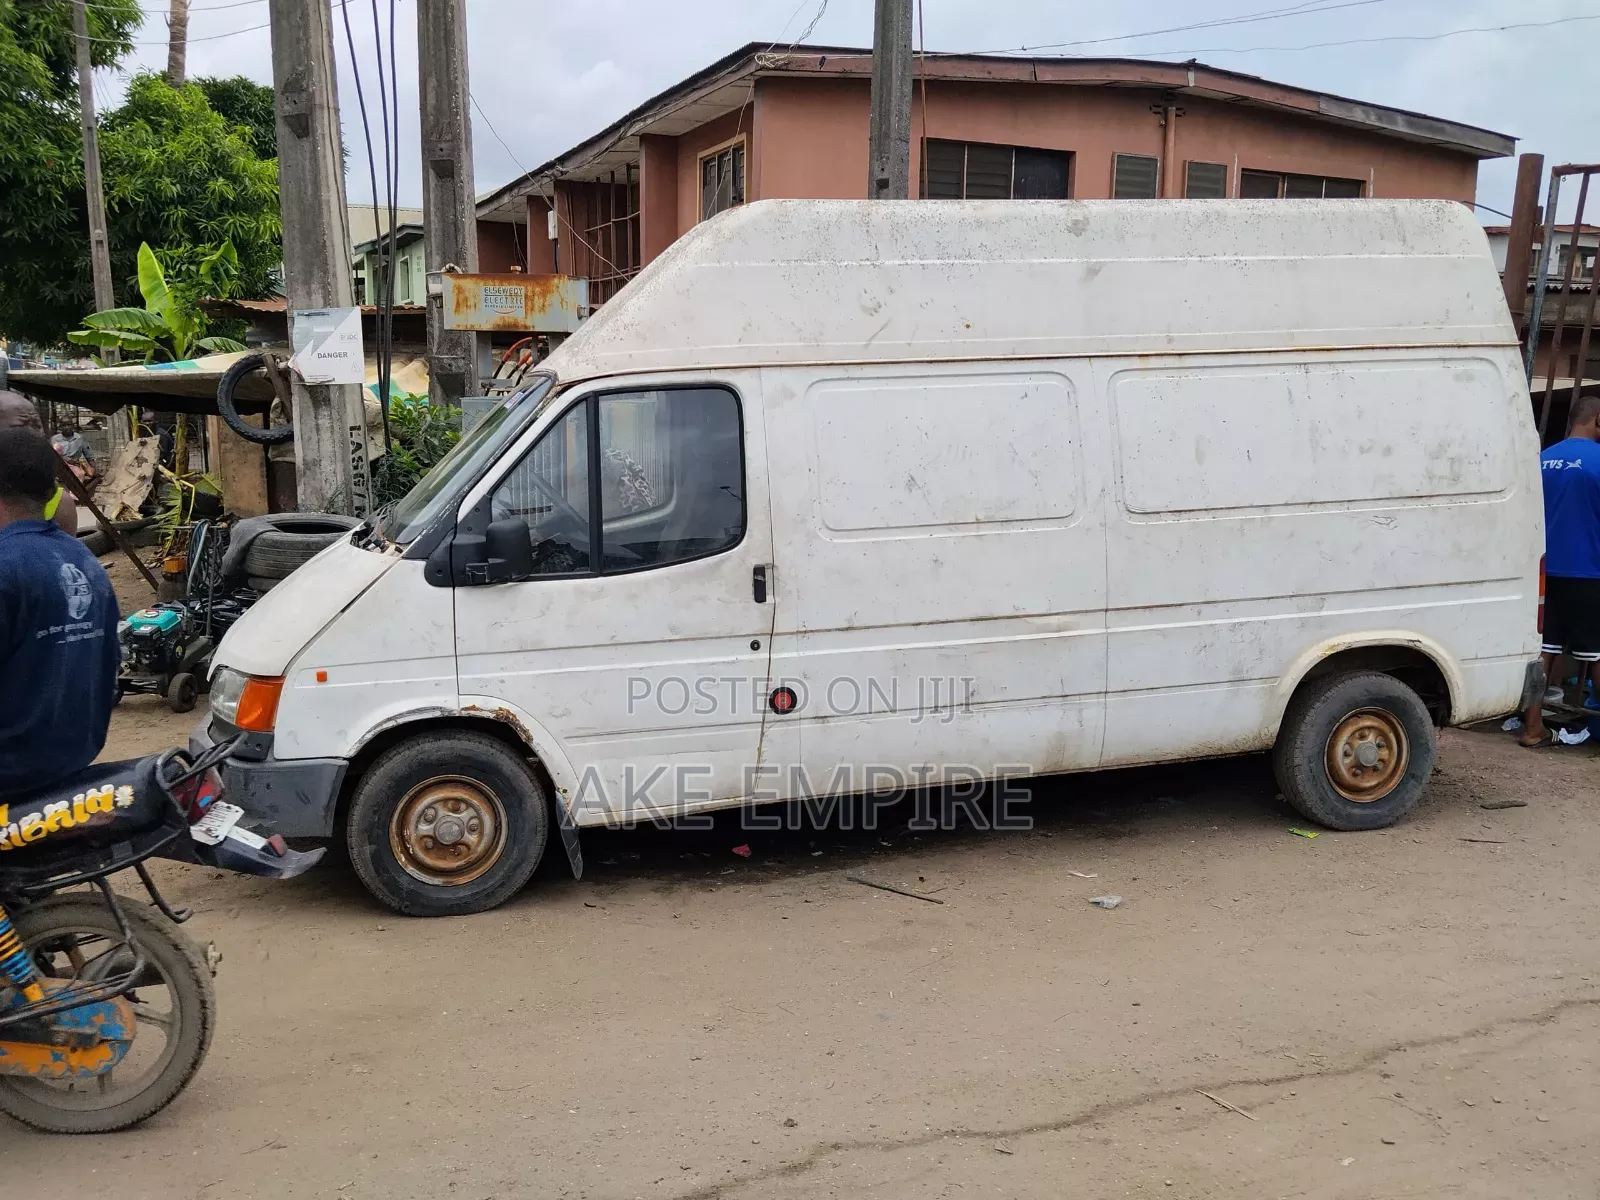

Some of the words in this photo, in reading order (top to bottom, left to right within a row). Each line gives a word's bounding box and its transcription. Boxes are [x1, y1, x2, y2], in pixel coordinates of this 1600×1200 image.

[484, 296, 523, 304] ELECTRIC
[317, 351, 348, 359] DANGER
[1542, 459, 1563, 469] TVS
